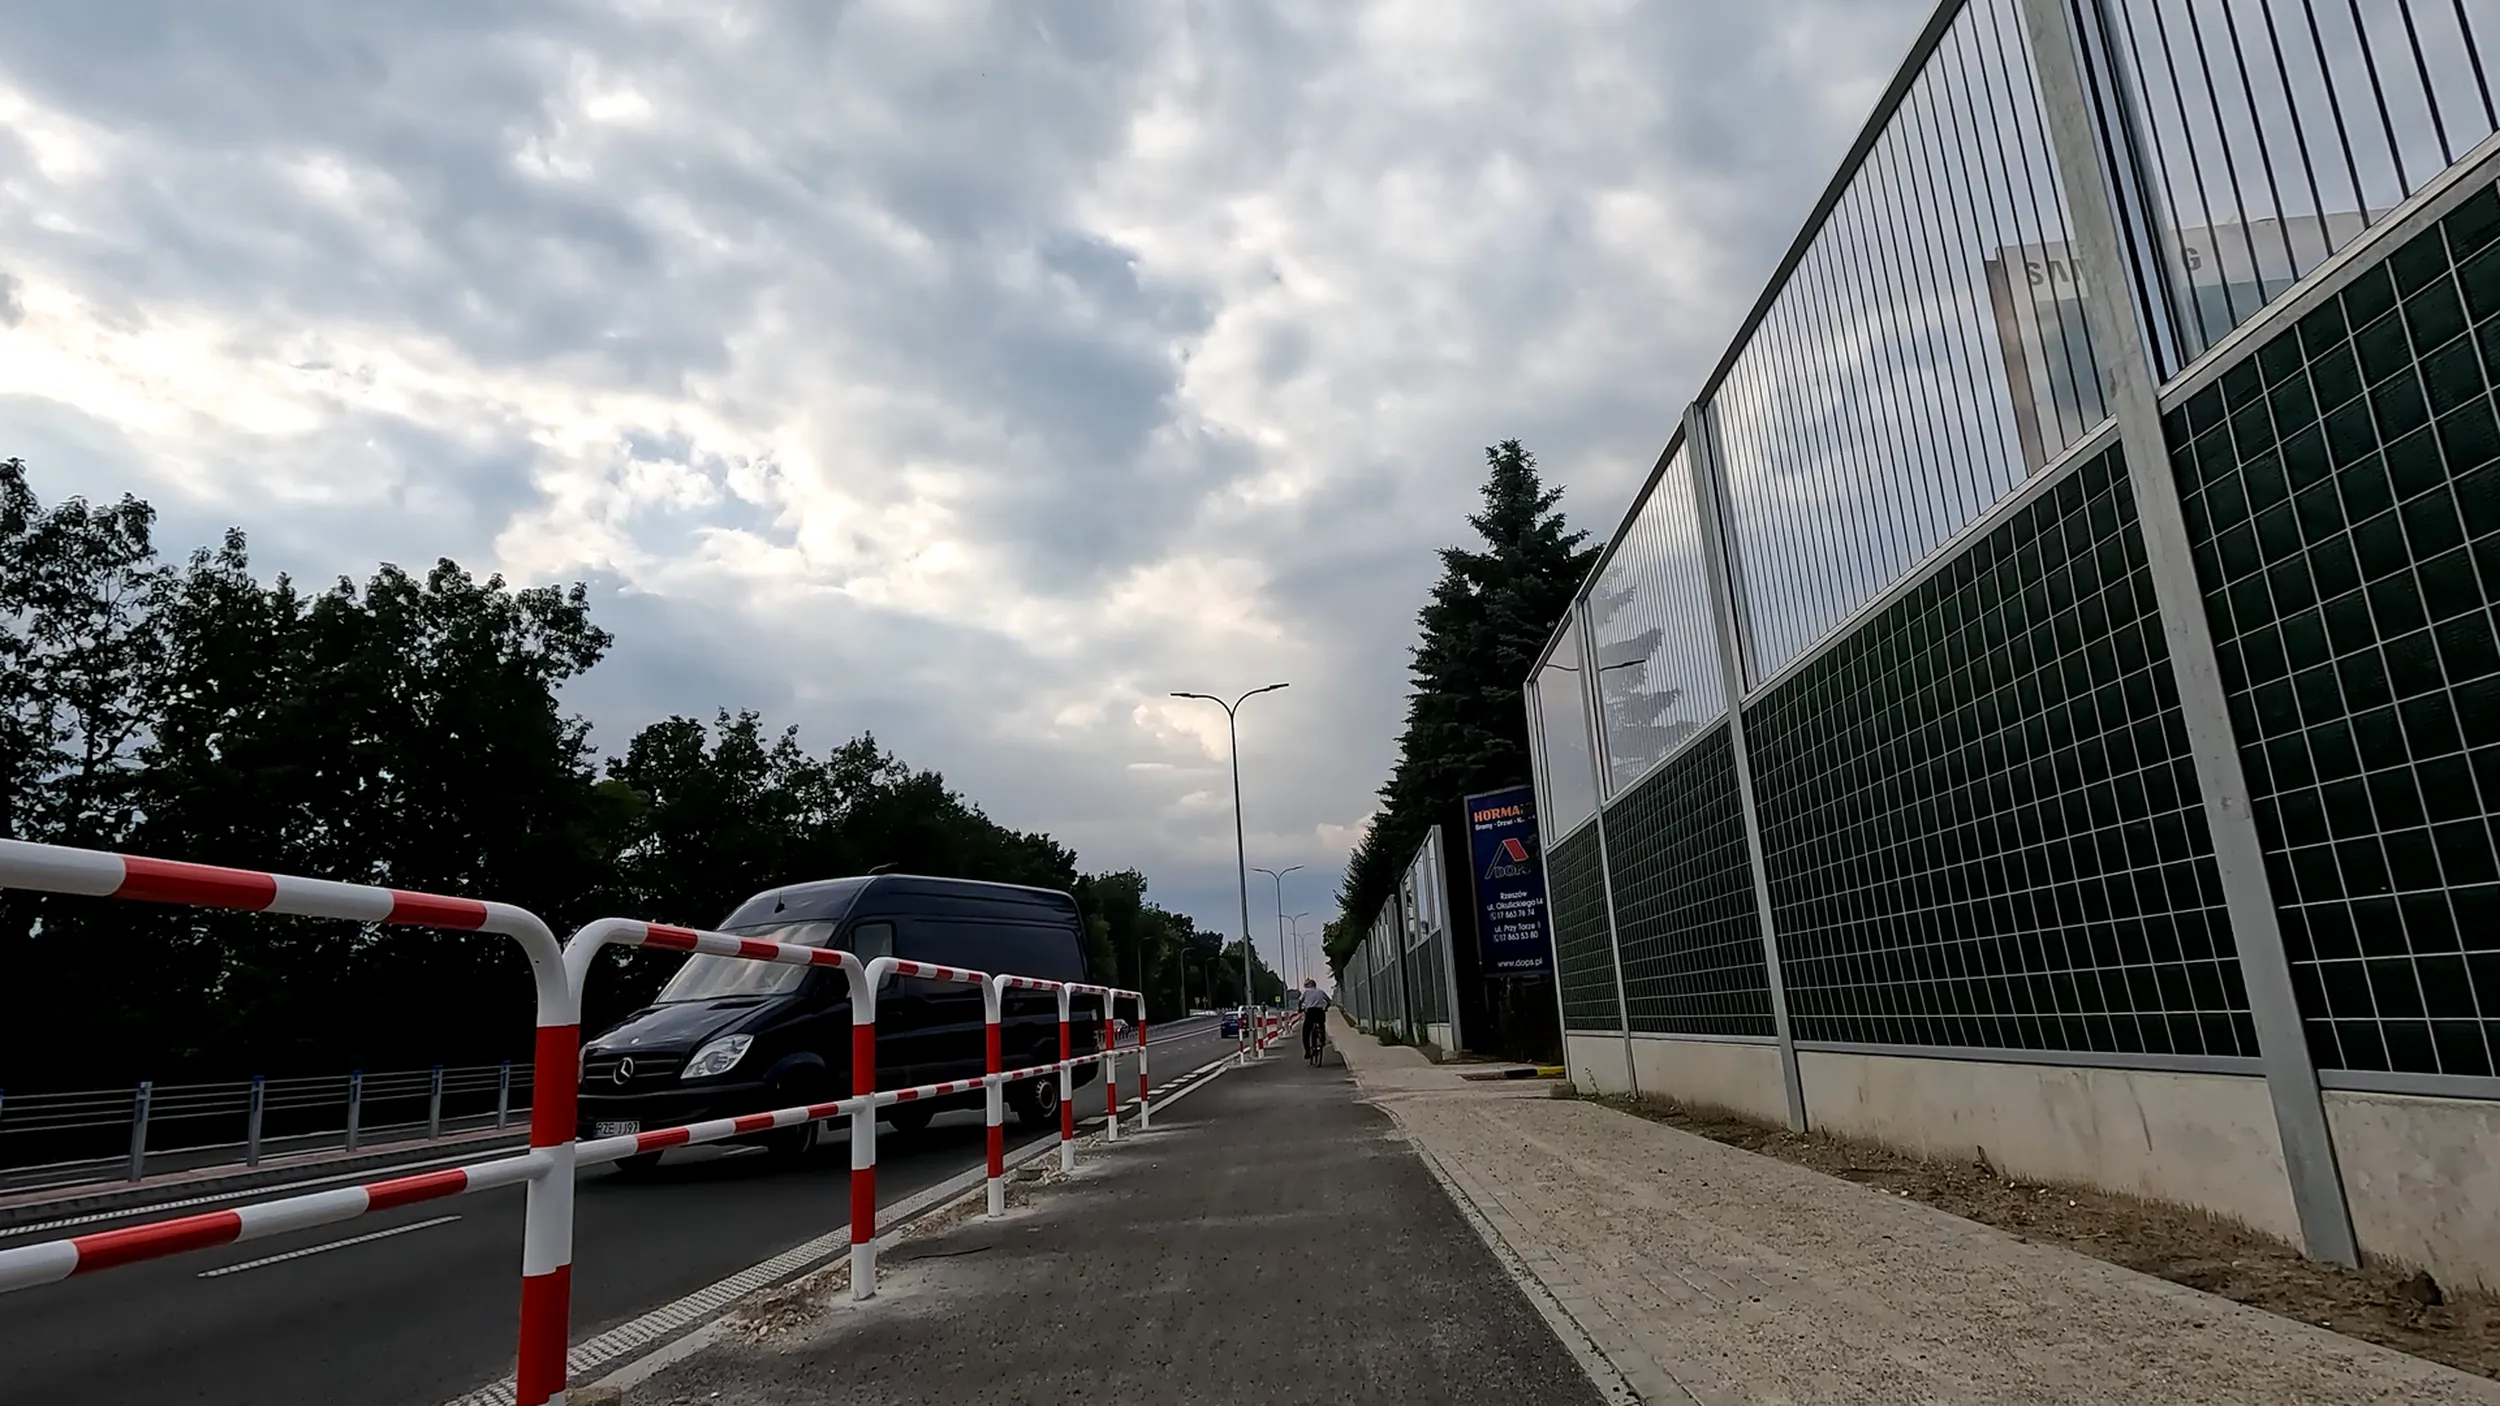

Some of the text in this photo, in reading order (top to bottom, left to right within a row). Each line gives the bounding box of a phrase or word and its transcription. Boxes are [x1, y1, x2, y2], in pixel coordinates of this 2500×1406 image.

[1500, 890, 1528, 900] Rzeszów
[1486, 903, 1496, 911] ul.
[1496, 899, 1535, 910] Okulickiego
[1497, 911, 1504, 919] 17
[1494, 925, 1502, 933] ul.
[1503, 924, 1517, 933] Przy
[1518, 923, 1535, 931] Torze
[1499, 933, 1506, 942] 17
[1497, 956, 1543, 968] www.dops.pl
[596, 1121, 614, 1134] RZE
